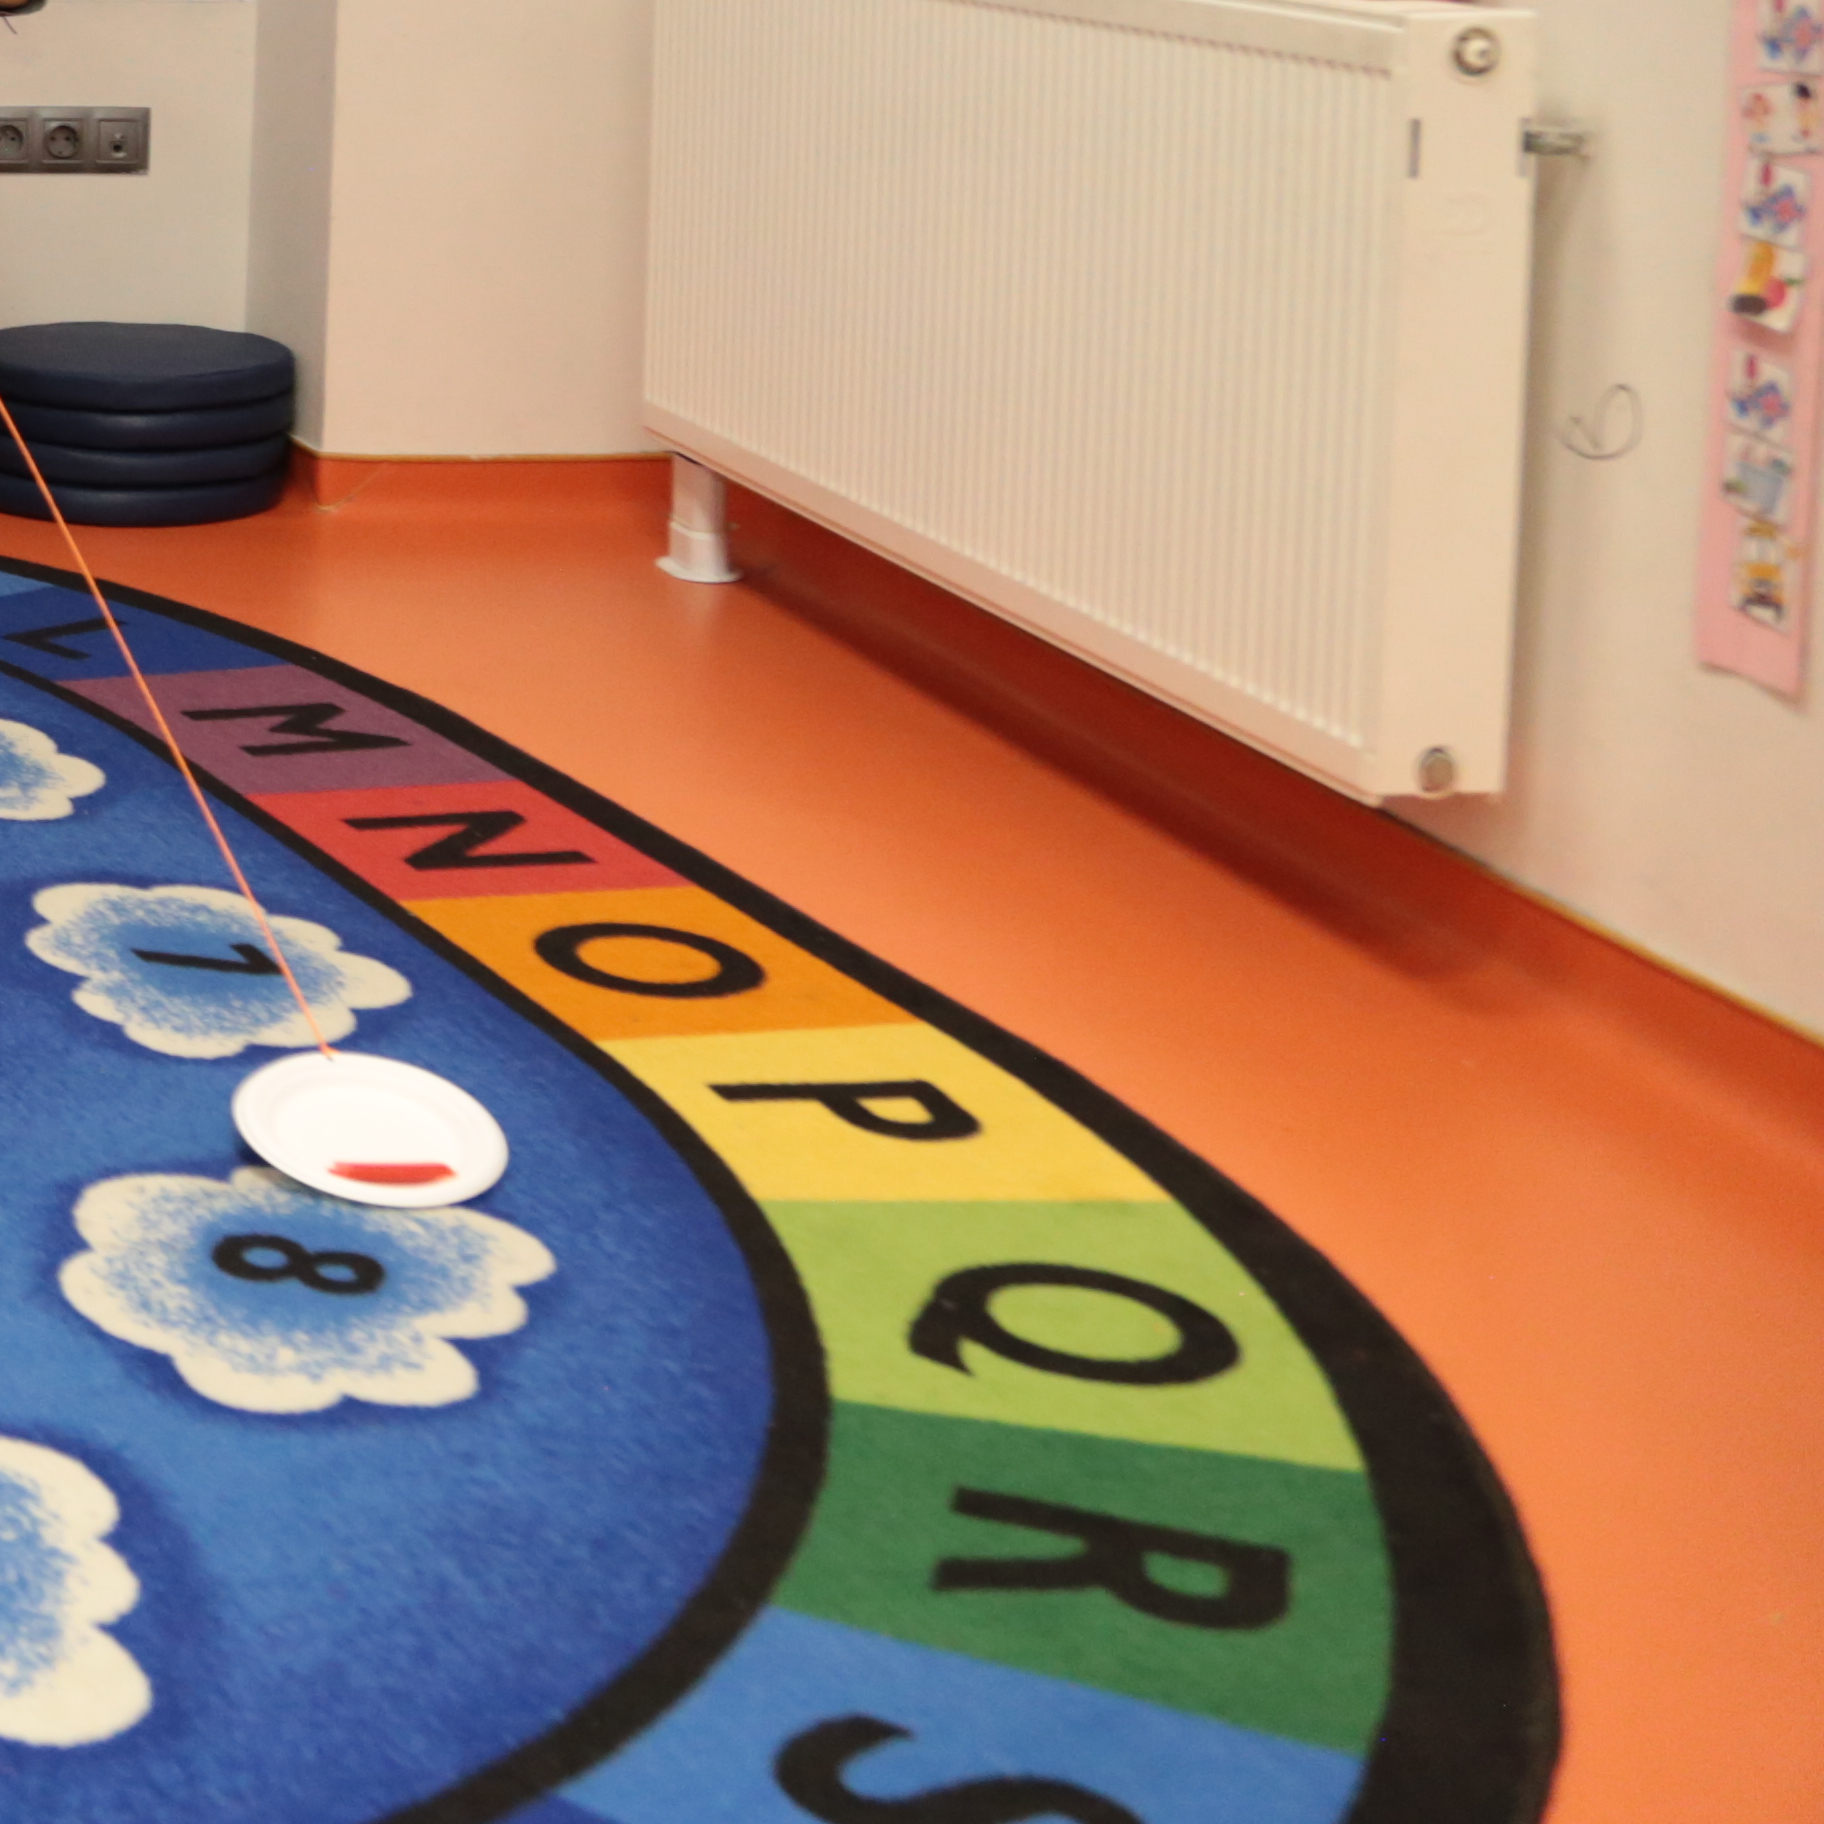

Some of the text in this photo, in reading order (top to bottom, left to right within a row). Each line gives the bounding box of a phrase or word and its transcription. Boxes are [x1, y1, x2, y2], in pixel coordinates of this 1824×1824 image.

[1, 618, 128, 662] L
[180, 701, 413, 758] M
[341, 809, 600, 873] N
[129, 943, 282, 977] 7
[533, 921, 767, 999] O
[708, 1078, 982, 1144] P
[210, 1232, 386, 1297] 8
[906, 1261, 1243, 1388] Q
[932, 1486, 1294, 1633] R
